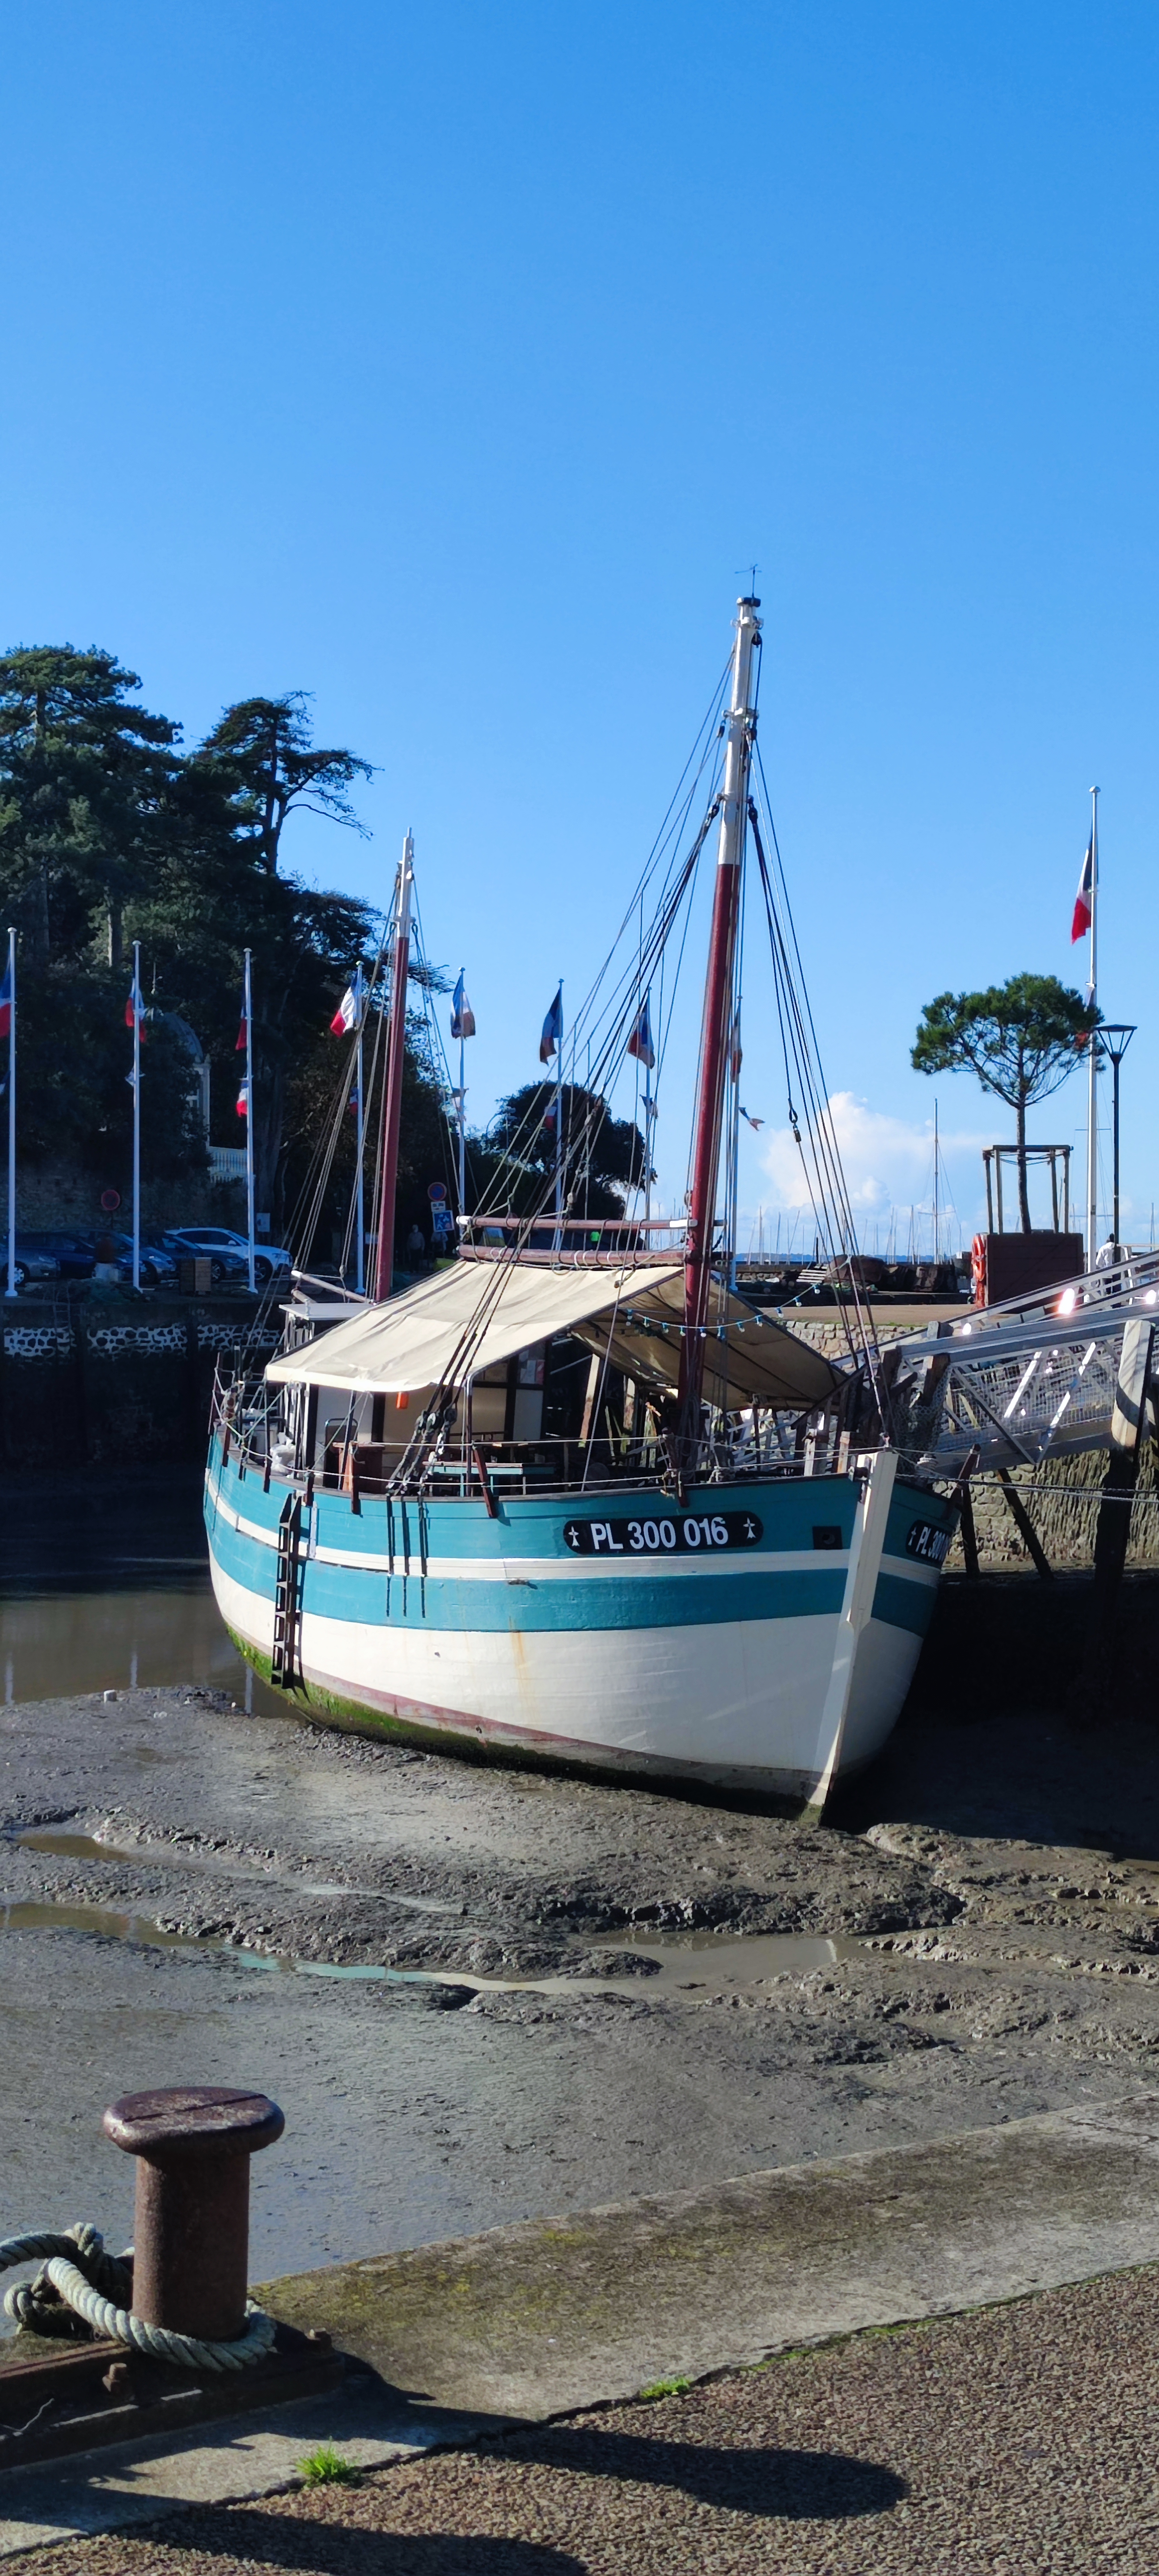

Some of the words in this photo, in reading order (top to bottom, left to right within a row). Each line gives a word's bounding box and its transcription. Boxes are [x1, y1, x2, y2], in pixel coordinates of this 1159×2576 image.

[590, 1523, 623, 1549] PL
[628, 1521, 676, 1549] 300
[684, 1517, 728, 1546] 016
[915, 1526, 932, 1555] PL
